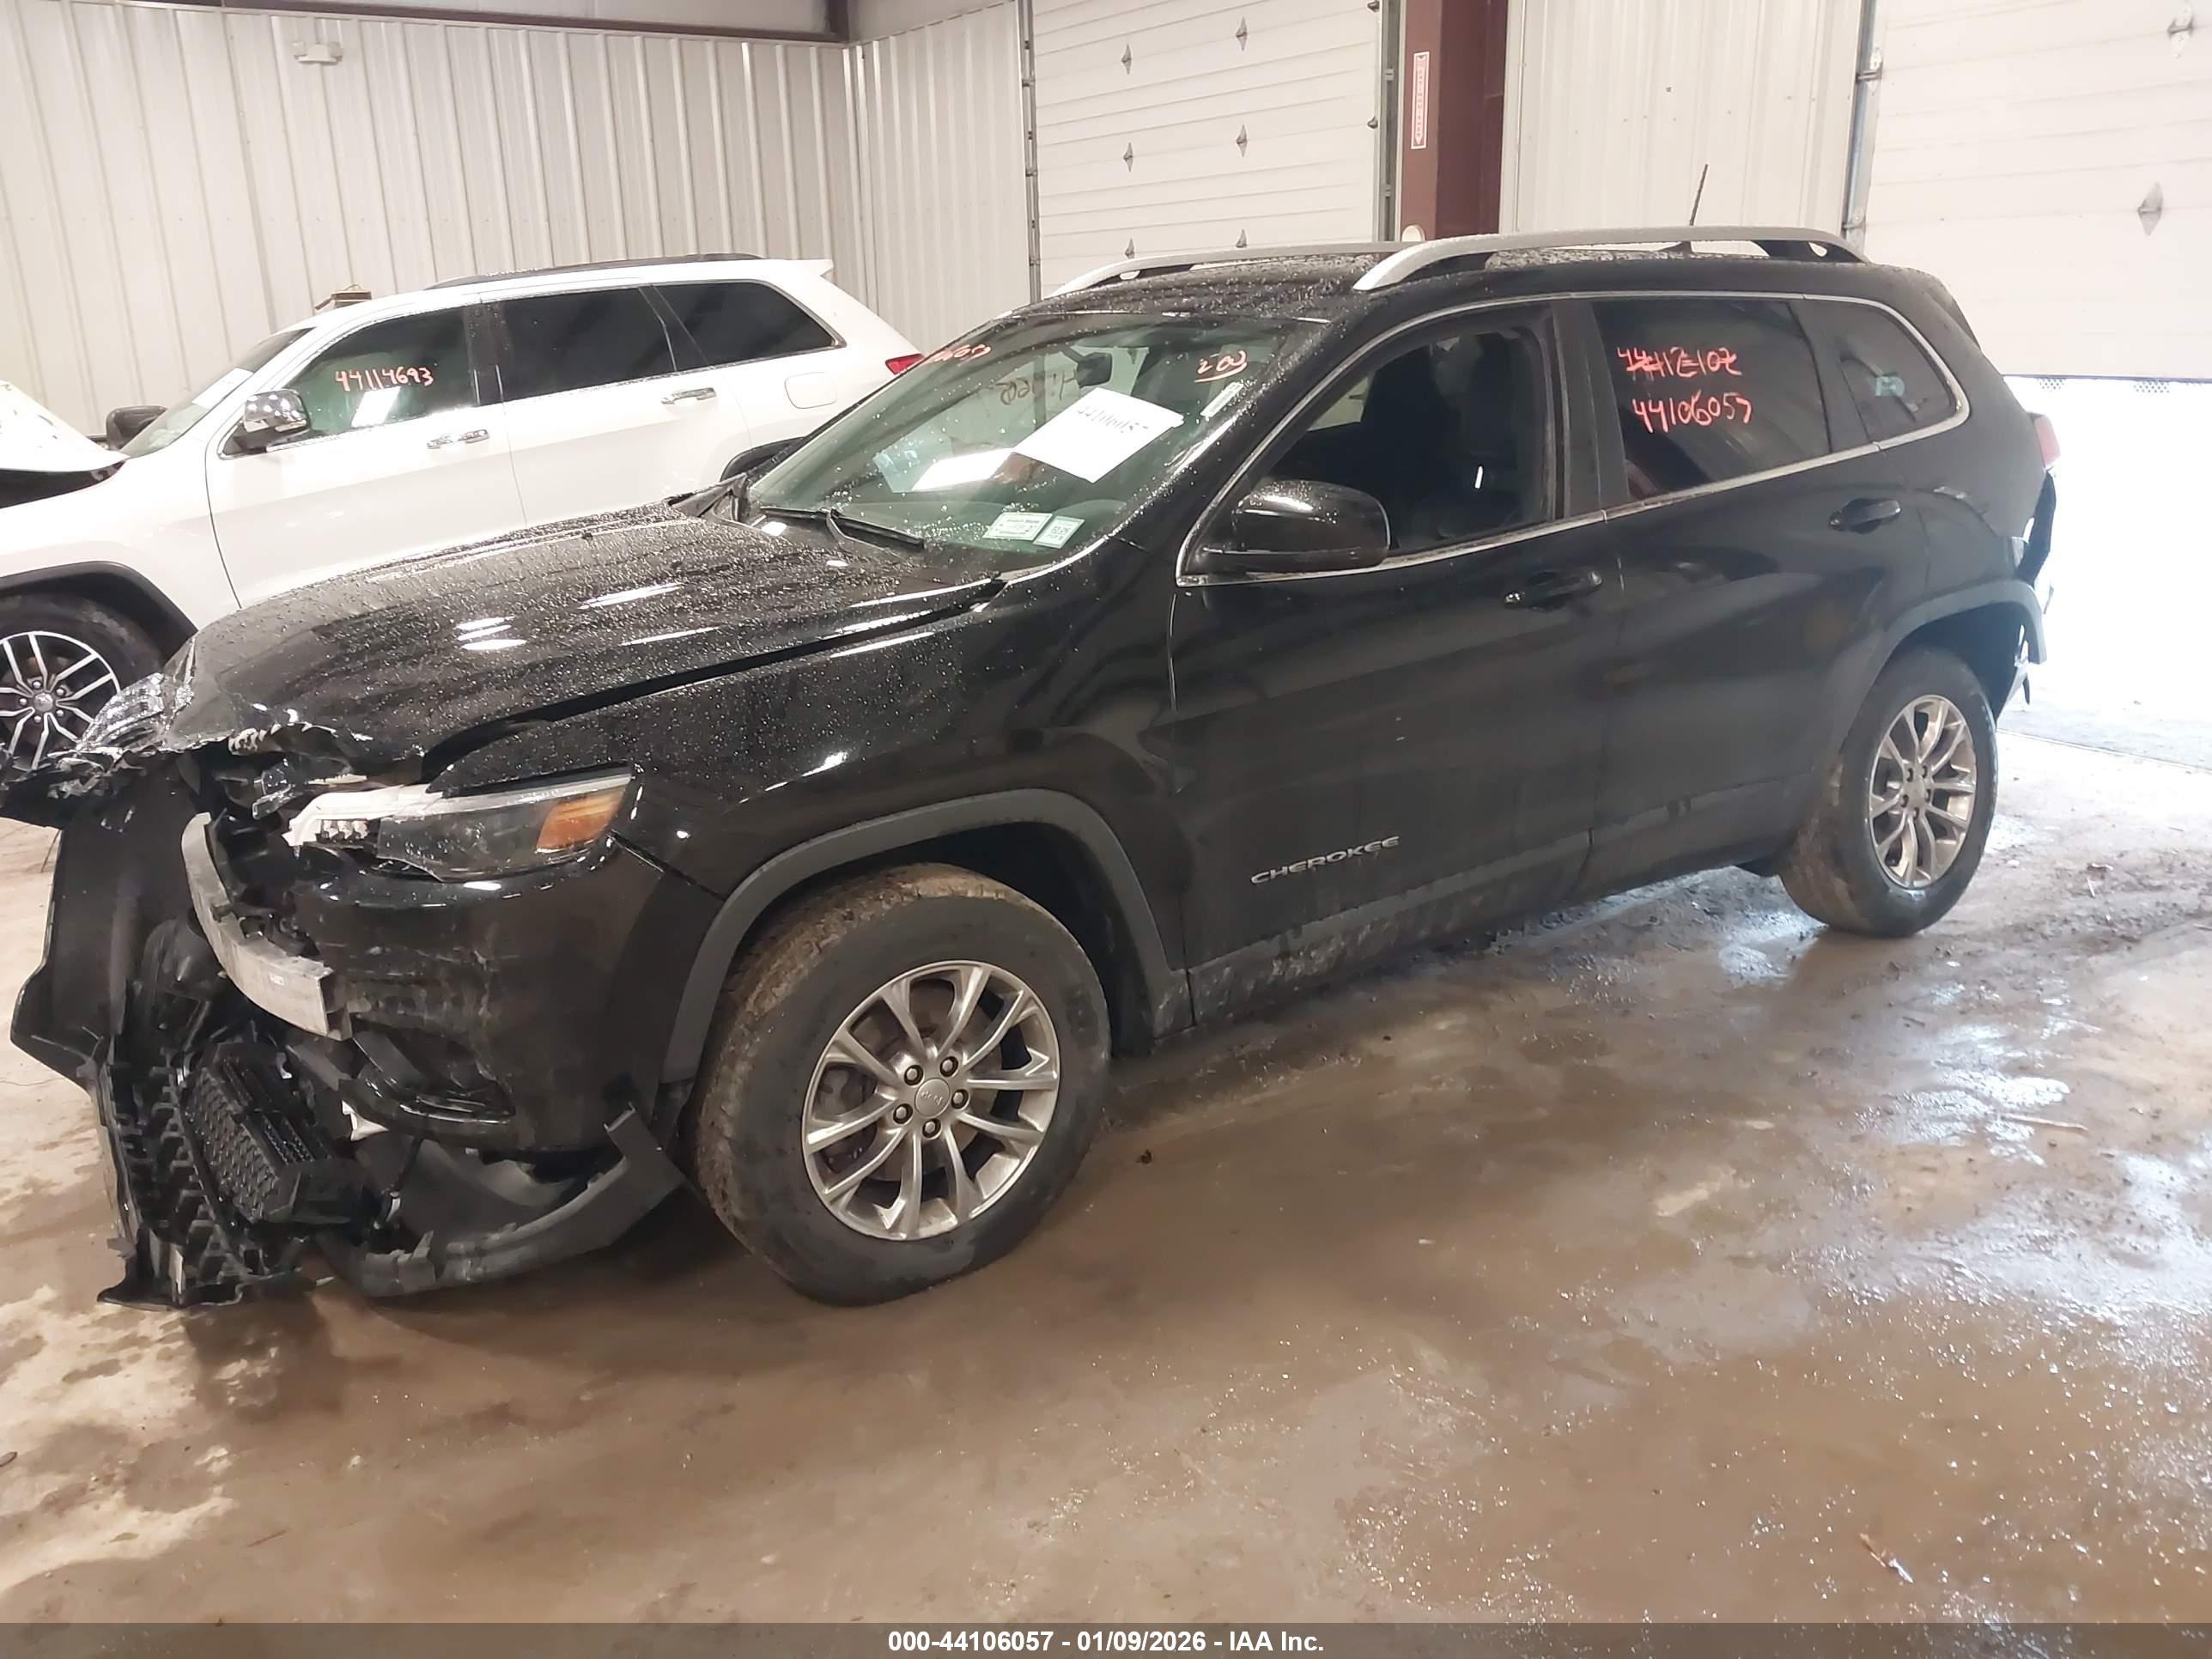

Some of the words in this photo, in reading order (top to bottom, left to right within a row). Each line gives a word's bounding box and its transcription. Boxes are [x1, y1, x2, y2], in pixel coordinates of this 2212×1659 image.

[334, 366, 434, 392] 44114693
[1632, 389, 1753, 434] 44106057
[1250, 836, 1401, 884] CHEROKEE
